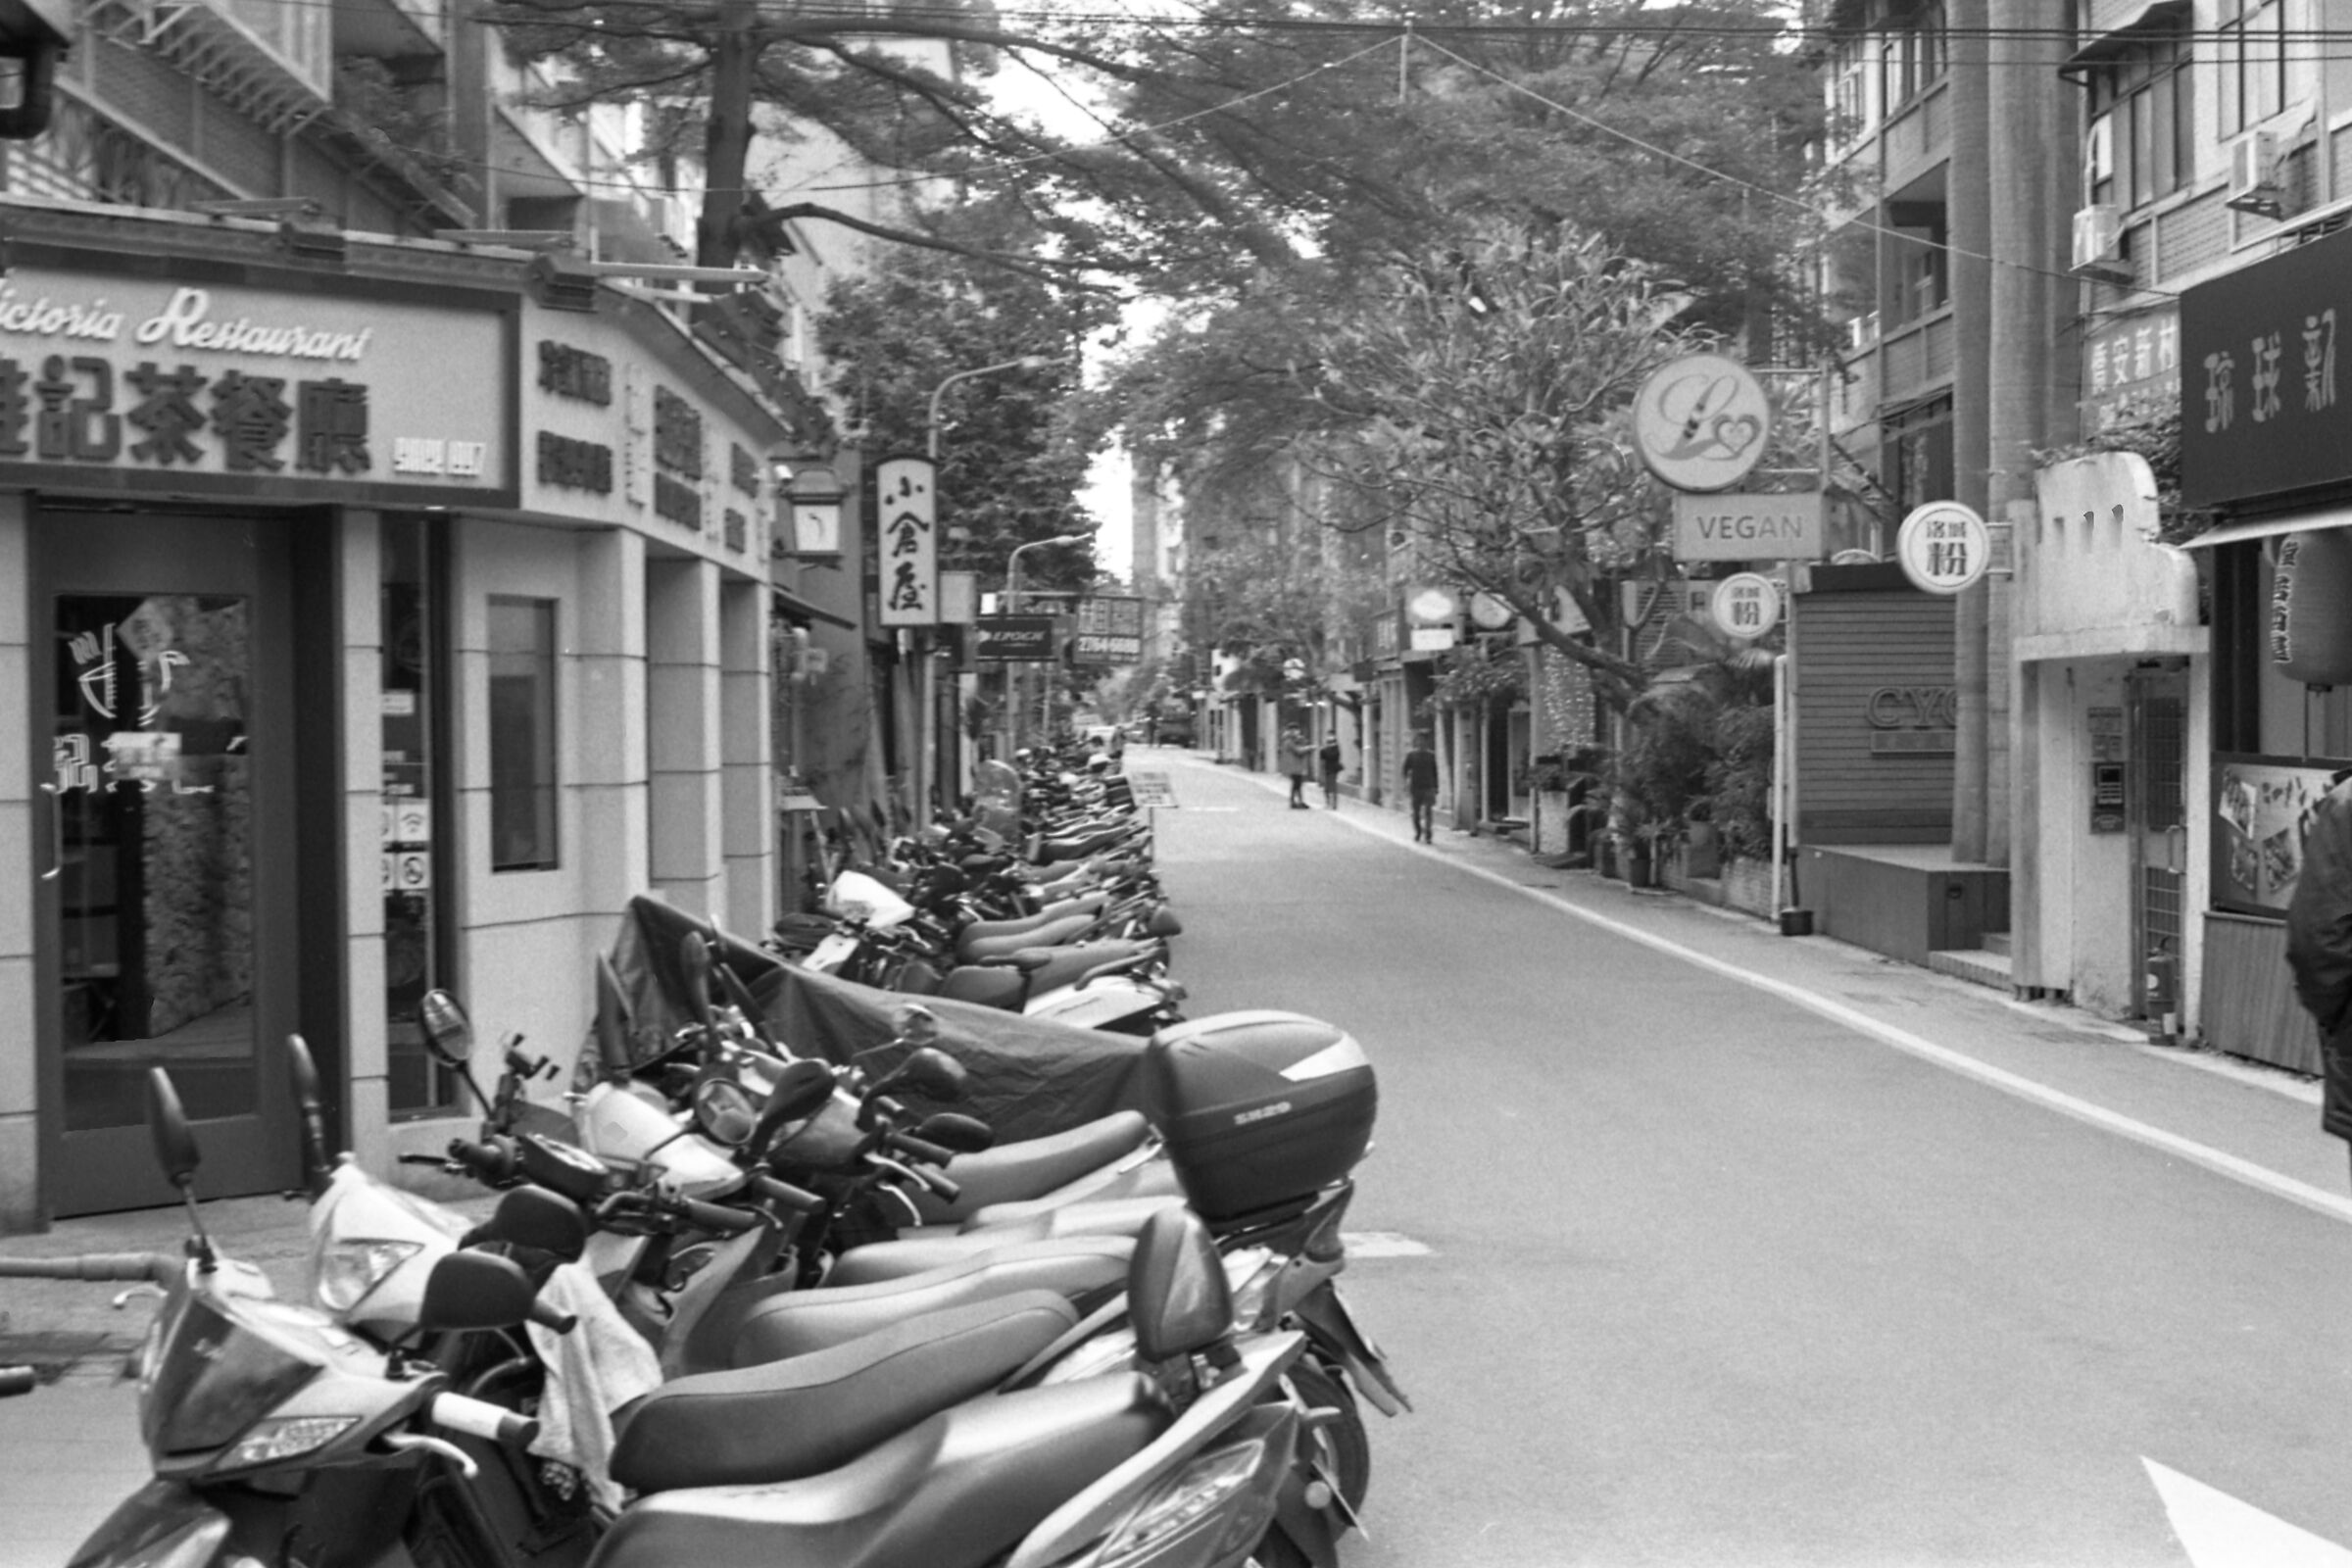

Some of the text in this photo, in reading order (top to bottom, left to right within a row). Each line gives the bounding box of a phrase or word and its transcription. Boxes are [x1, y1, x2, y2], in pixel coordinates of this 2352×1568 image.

[0, 270, 374, 360] ictoria Restaurant
[884, 476, 929, 612] 小倉屋
[1696, 514, 1803, 539] VEGAN
